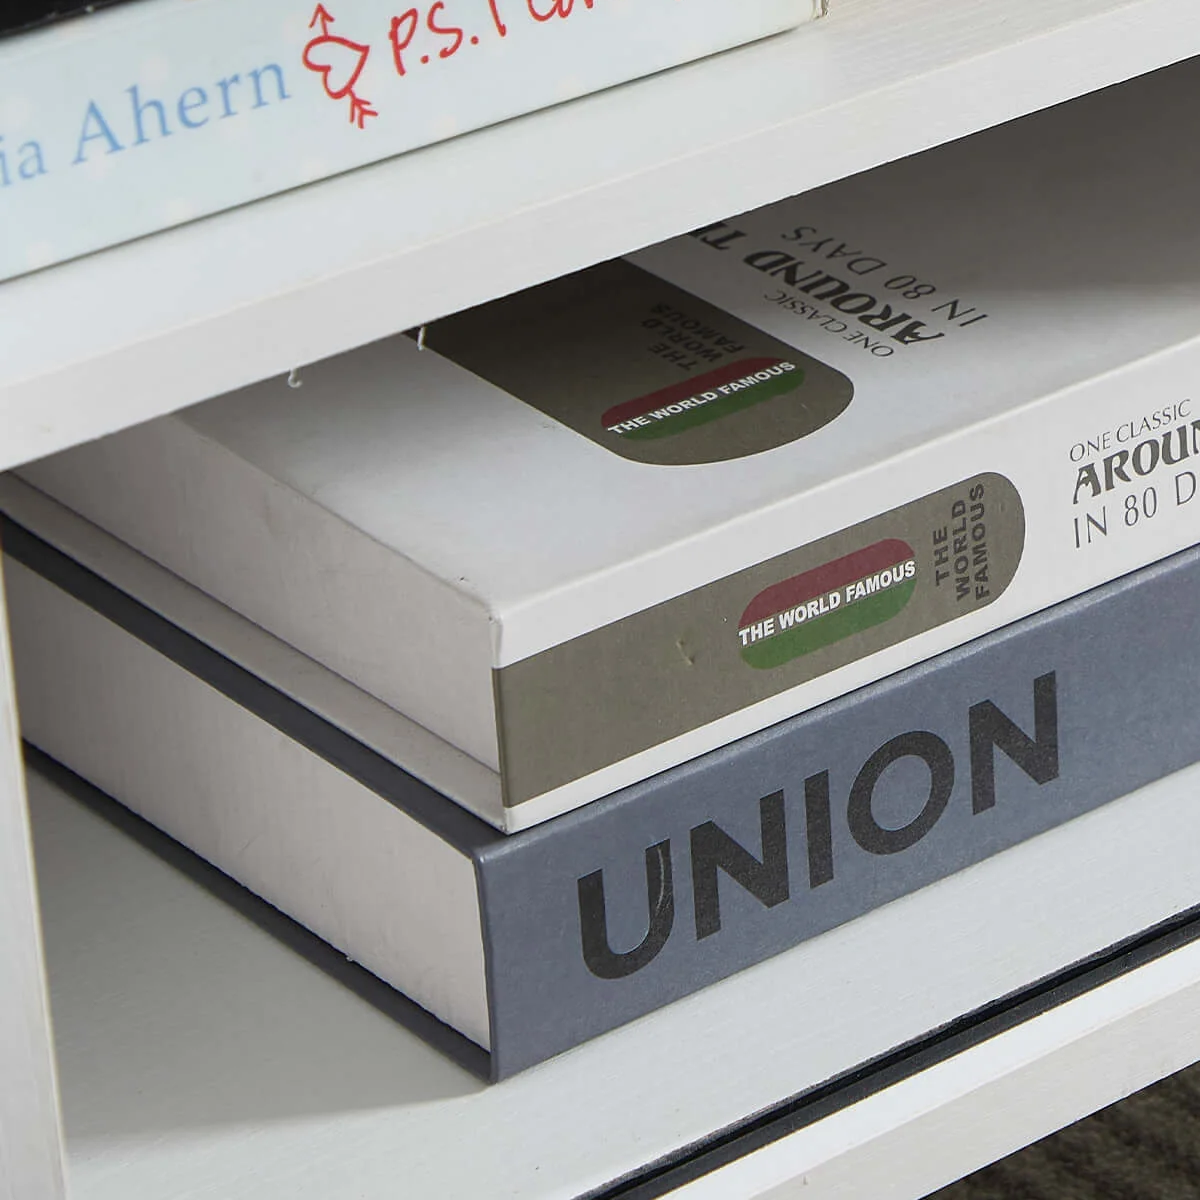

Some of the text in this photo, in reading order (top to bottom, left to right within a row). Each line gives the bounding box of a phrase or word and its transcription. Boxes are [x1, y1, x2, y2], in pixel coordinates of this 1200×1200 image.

[71, 62, 291, 166] Ahern
[780, 226, 887, 276] DAYS
[743, 250, 945, 345] AROUND
[883, 274, 936, 300] 80
[931, 298, 988, 327] IN
[641, 319, 721, 363] WORLD
[651, 303, 744, 354] FAMOUS
[764, 289, 894, 358] ONE CLASSIC
[647, 344, 695, 372] THE
[607, 361, 797, 436] THE WORLD FAMOUS
[1069, 399, 1192, 462] ONE CLASSIC
[970, 483, 991, 600] FAMOUS
[1073, 505, 1109, 549] IN
[1123, 486, 1158, 527] 80
[933, 526, 950, 586] THE
[951, 500, 970, 602] WORLD
[738, 560, 916, 647] THE WORLD FAMOUS
[577, 670, 1060, 980] UNION
